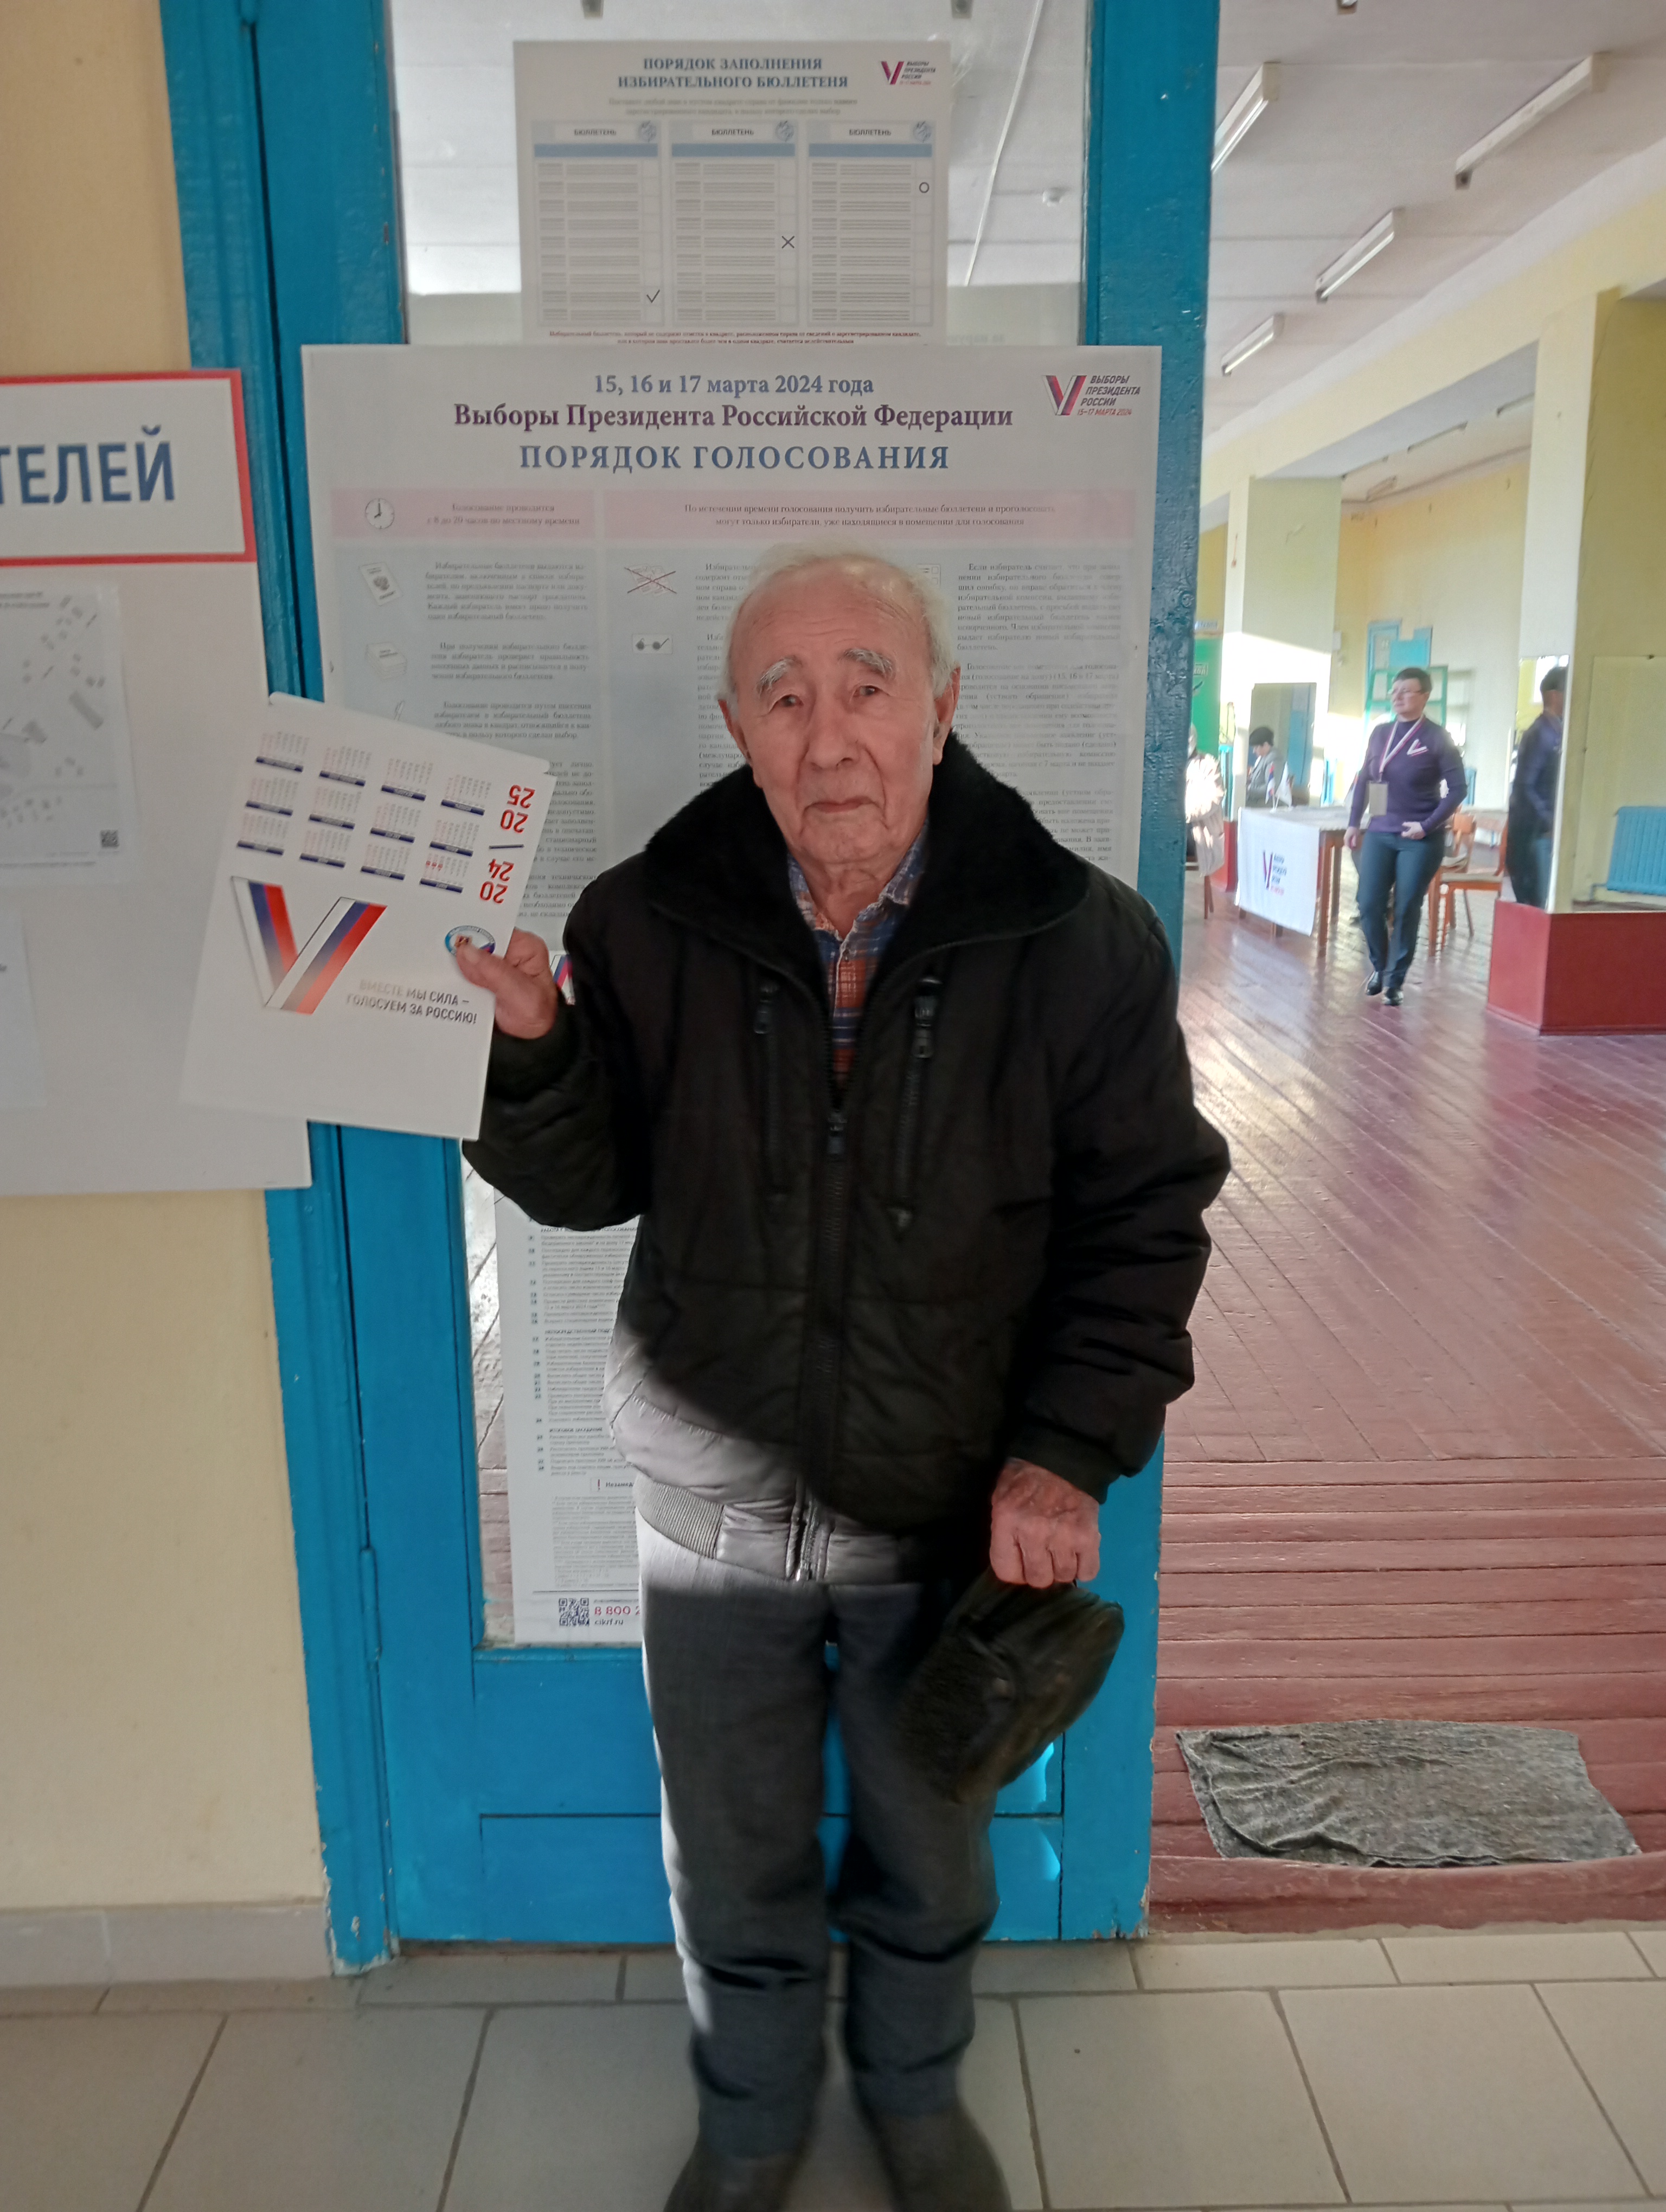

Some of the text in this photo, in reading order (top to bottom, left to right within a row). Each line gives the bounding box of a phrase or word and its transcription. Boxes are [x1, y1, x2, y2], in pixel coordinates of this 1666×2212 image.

[644, 58, 822, 71] ПОРЯДОК ЗАПОЛНЕНИЯ
[618, 76, 848, 88] ИЗБИРАТЕЛЬНОГО БЮЛЛЕТЕНЯ
[573, 128, 617, 137] БЮЛЛЕТЕНЬ
[711, 128, 754, 137] БЮЛЛЕТЕНЬ
[848, 128, 892, 137] БЮЛЛЕТЕНЬ
[1090, 375, 1131, 384] ВЫБОРЫ
[595, 375, 874, 398] 15, 16 и 17 марта 2024 года
[1085, 386, 1141, 396] ПРЕЗИДЕНТА
[1080, 397, 1117, 406] РОССИИ
[454, 403, 1013, 432] Выборы Президента Российской Федерации
[1095, 408, 1116, 416] МАРТА
[520, 445, 949, 473] ПОРЯДОК ГОЛОСОВАНИЯ
[507, 785, 535, 808] 25
[501, 809, 528, 833] 20
[489, 859, 514, 882] 24
[480, 881, 508, 904] 20
[360, 979, 403, 996] ВМЕСТЕ
[407, 988, 426, 1000] МЫ
[430, 991, 459, 1006] СИЛА
[347, 993, 477, 1025] ГОЛОСУЕМ ЗА РОССИЮ!
[606, 1606, 631, 1615] 800
